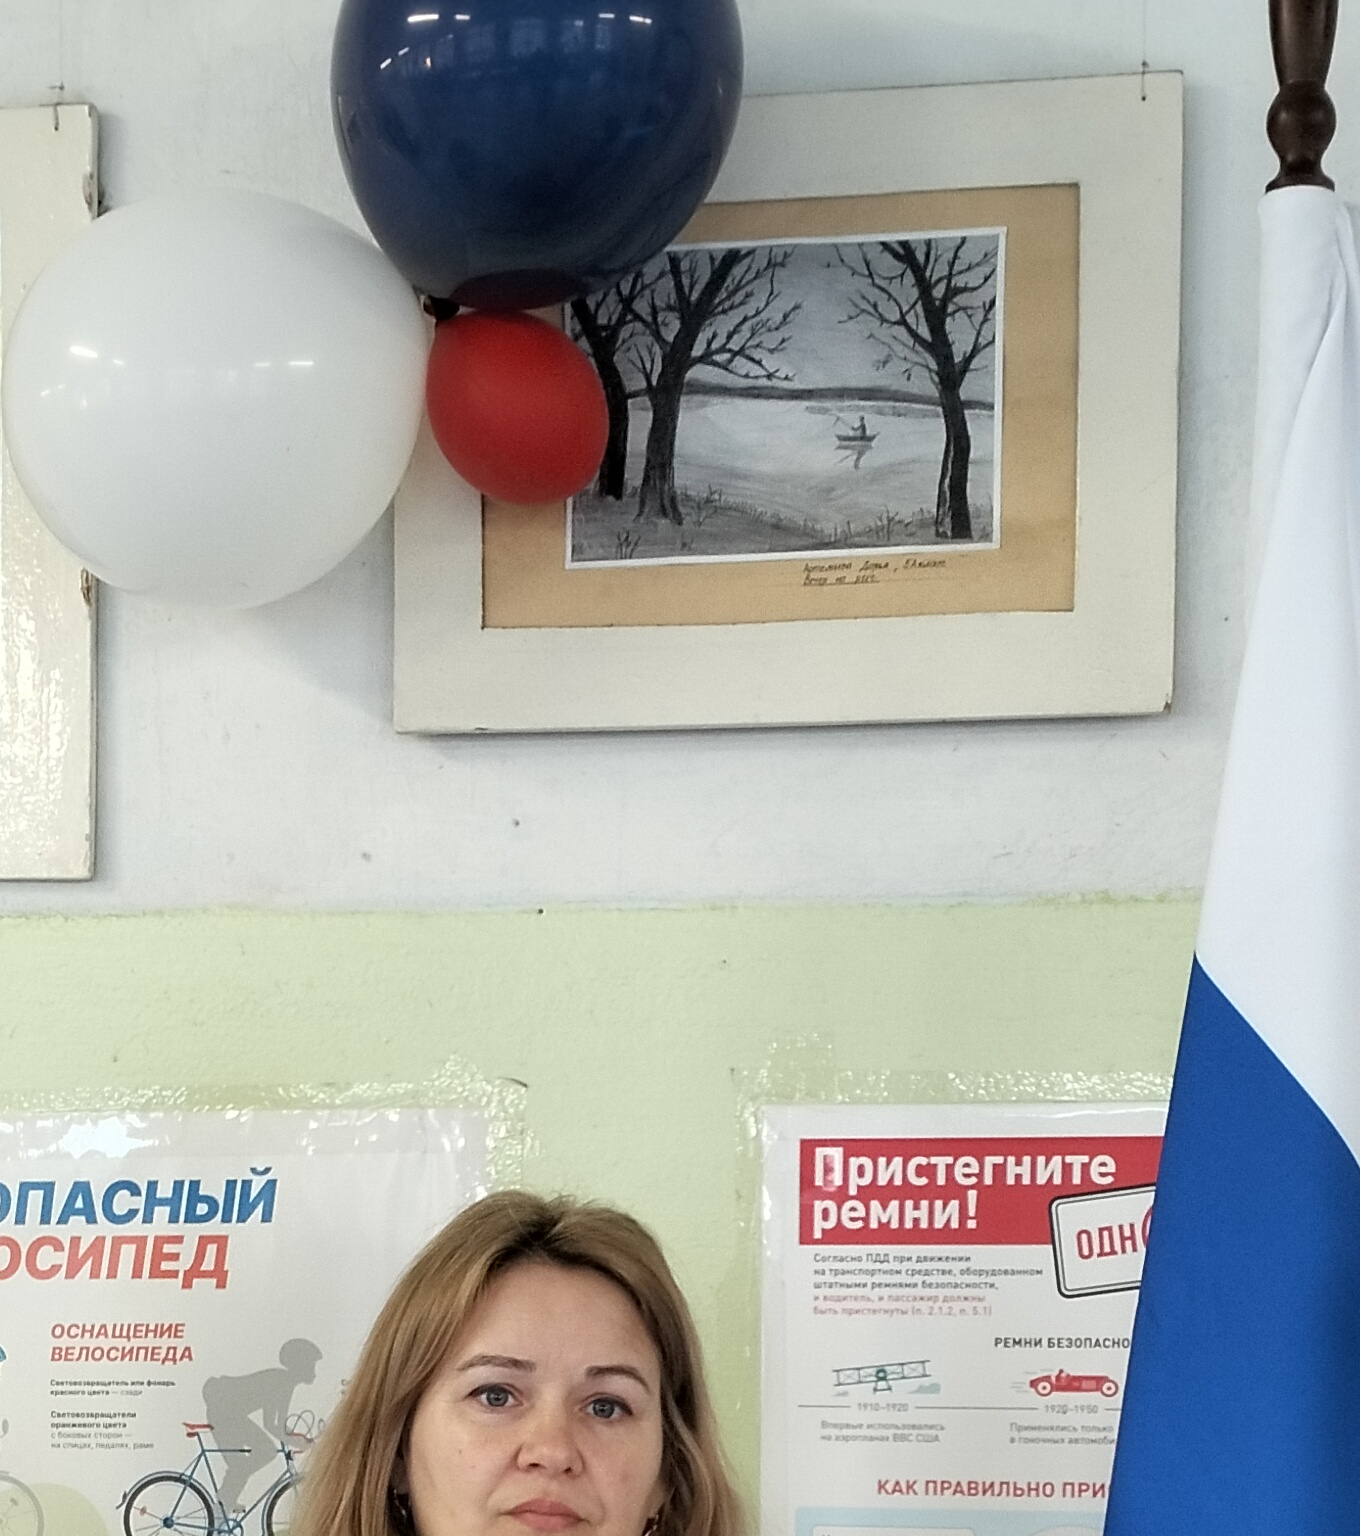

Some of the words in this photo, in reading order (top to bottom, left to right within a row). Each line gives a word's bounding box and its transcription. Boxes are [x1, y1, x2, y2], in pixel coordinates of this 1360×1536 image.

[814, 1147, 1117, 1196] Пристегните
[813, 1190, 978, 1240] ремни!
[813, 1254, 863, 1264] Согласно
[866, 1254, 890, 1264] ПДД
[893, 1254, 913, 1264] при
[915, 1254, 972, 1264] движении
[813, 1268, 826, 1276] на
[829, 1268, 902, 1278] транспортном
[905, 1268, 956, 1278] средстве,
[959, 1267, 1043, 1278] оборудованном
[813, 1281, 868, 1290] штатными
[921, 1280, 999, 1291] безопасности,
[50, 1323, 186, 1342] ОСНАЩЕНИЕ
[994, 1337, 1043, 1349] РЕМНИ
[1047, 1337, 1130, 1349] БЕЗОПАСНО
[50, 1346, 194, 1365] ВЕЛОСИПЕДА
[50, 1379, 129, 1388] Световозвращатель
[146, 1379, 176, 1388] фонарь
[50, 1410, 137, 1419] Световозвращатели
[50, 1421, 101, 1430] оранжевого
[102, 1421, 127, 1430] цвета
[877, 1479, 918, 1496] КАК
[924, 1480, 1055, 1498] ПРАВИЛЬНО
[1062, 1482, 1106, 1499] ПРИ
